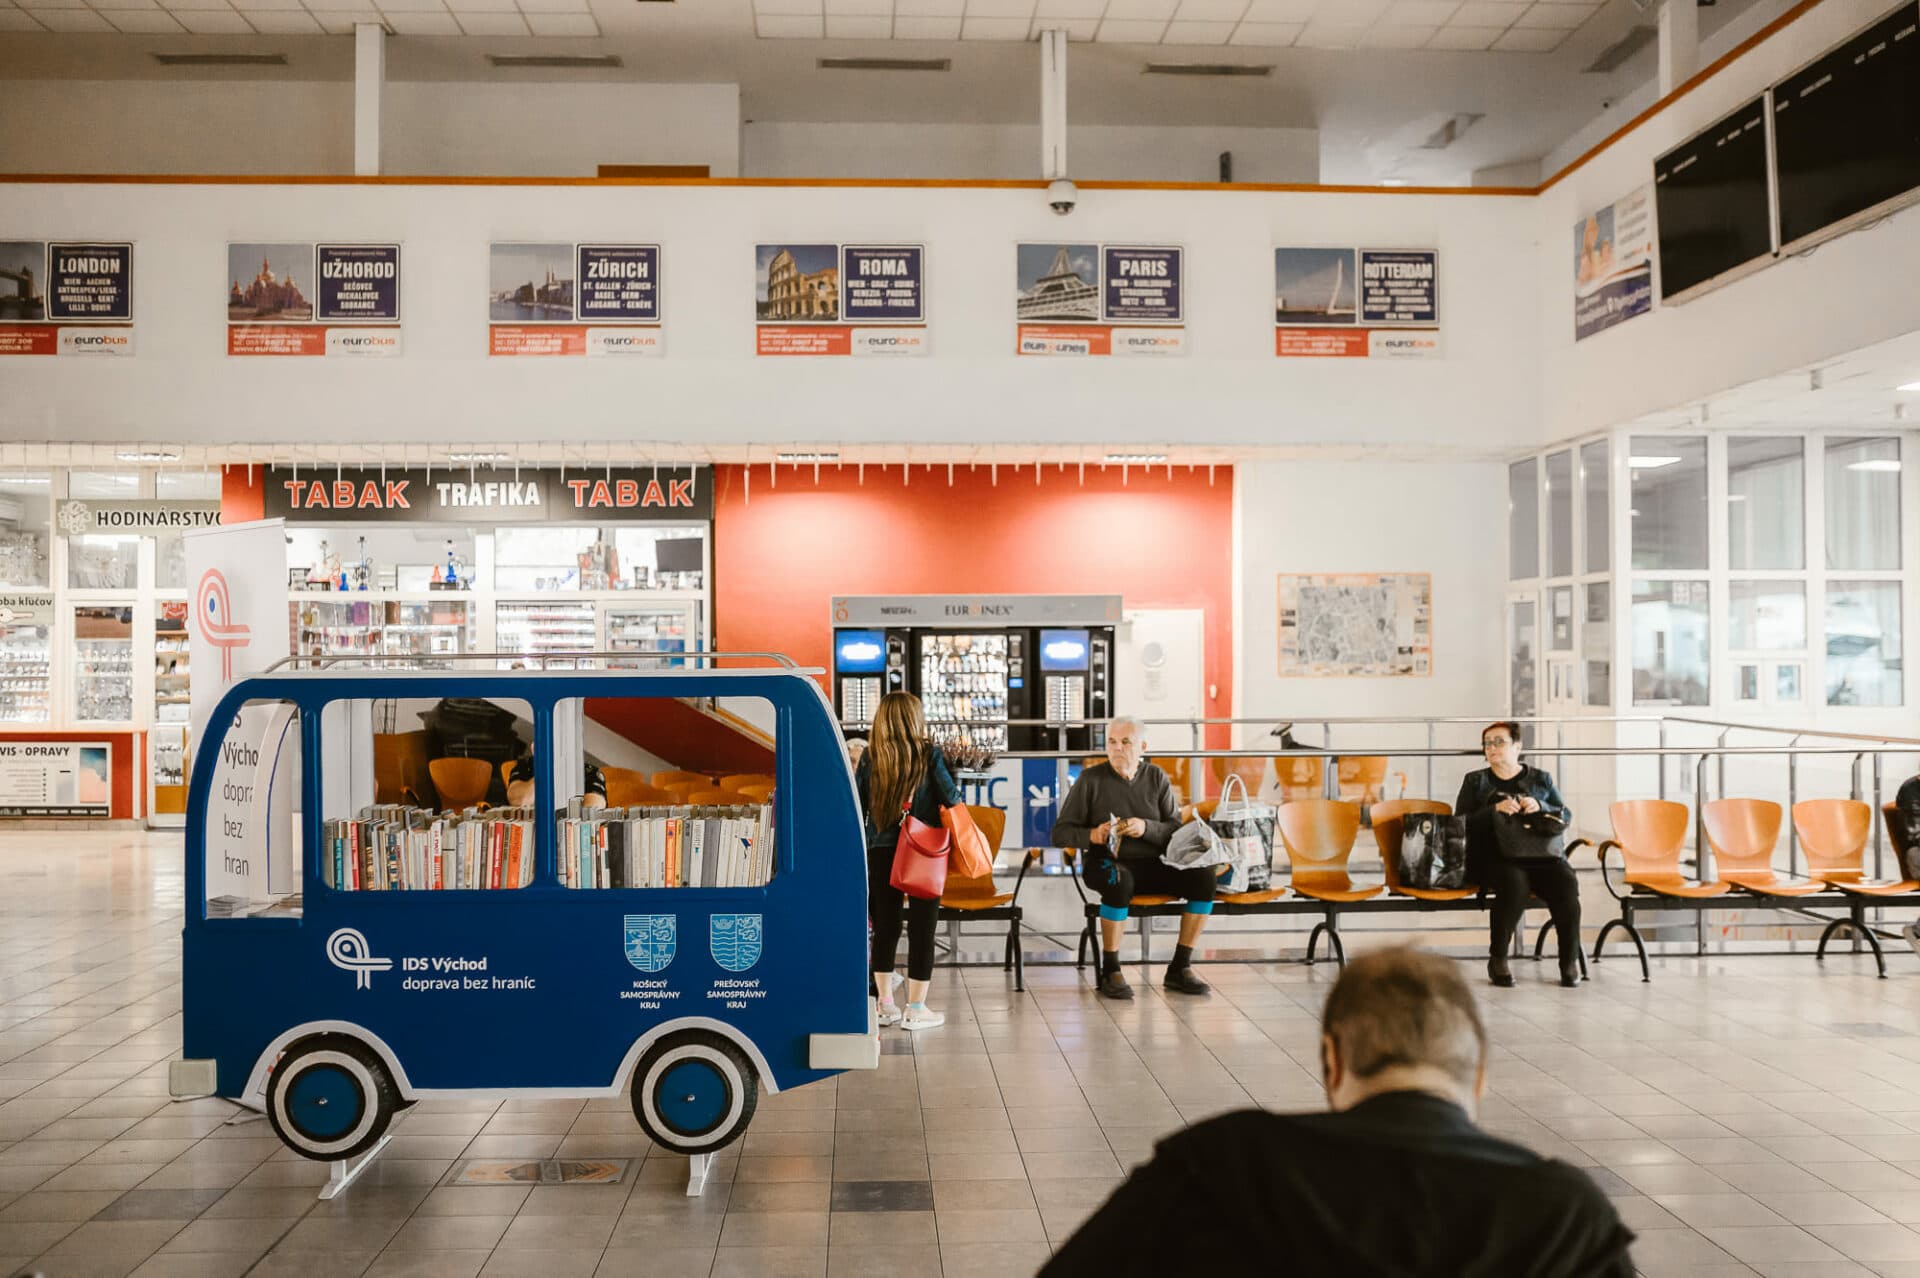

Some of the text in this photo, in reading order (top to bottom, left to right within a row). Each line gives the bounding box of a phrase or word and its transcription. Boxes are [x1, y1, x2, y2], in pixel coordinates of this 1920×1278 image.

[60, 258, 120, 274] LONDON
[322, 258, 395, 279] UŽHOROD
[588, 258, 649, 278] ZÜRICH
[859, 259, 908, 276] ROMA
[1120, 260, 1168, 276] PARIS
[1364, 263, 1433, 279] ROTTERDAM
[74, 336, 128, 345] eurobus
[342, 336, 396, 346] eurobus
[603, 336, 656, 346] eurobus
[284, 480, 411, 508] TABAK
[436, 482, 540, 507] TRAFIKA
[568, 480, 694, 508] TABAK
[25, 747, 70, 756] OPRAVY
[224, 813, 243, 838] bez
[402, 956, 488, 974] IDS Východ
[402, 976, 536, 992] doprava bez hraníc
[632, 980, 668, 988] KOŠICKÝ
[714, 978, 760, 988] PREŠOVSKÝ
[620, 990, 681, 999] SAMOSPRÁVNY
[706, 990, 768, 998] SAMOSPRÁVNY
